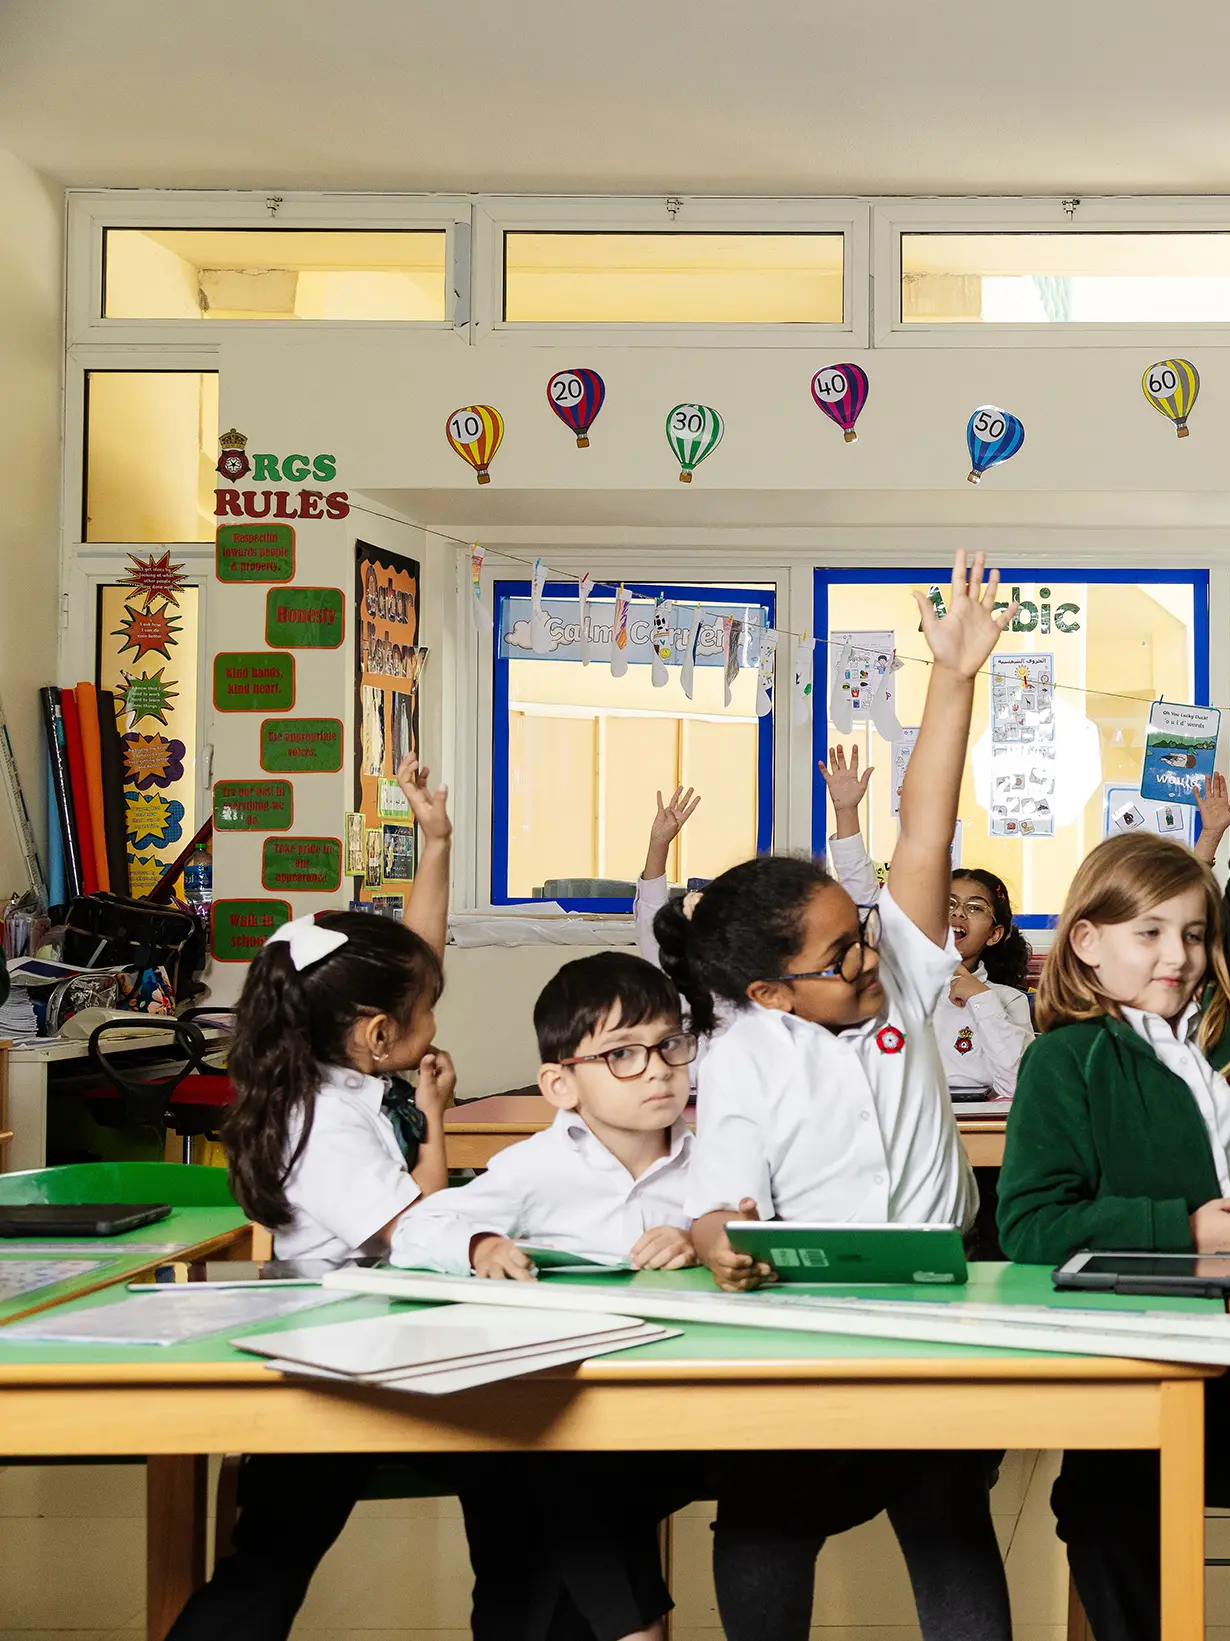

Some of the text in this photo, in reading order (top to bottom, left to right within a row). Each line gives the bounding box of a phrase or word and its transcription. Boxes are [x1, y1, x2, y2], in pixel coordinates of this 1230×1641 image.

[553, 378, 582, 401] 20
[816, 374, 846, 396] 40
[1148, 370, 1176, 393] 60
[451, 416, 480, 440] 10
[673, 411, 702, 434] 30
[974, 412, 1005, 438] 50
[252, 454, 336, 482] RGS
[214, 489, 350, 520] RULES
[233, 533, 278, 543] Respectful
[222, 547, 288, 558] towards people
[230, 562, 236, 570] &
[366, 565, 414, 625] Qatar
[276, 606, 336, 626] Honesty
[918, 586, 1080, 634] Abic
[630, 620, 724, 648] Crer
[226, 668, 248, 678] Kind
[228, 684, 250, 694] kind
[268, 732, 336, 742] Use appropriate
[288, 748, 317, 757] voices.
[238, 788, 253, 796] our
[256, 787, 274, 796] best
[276, 786, 284, 796] in
[272, 802, 284, 810] we
[274, 844, 332, 854] Take pride in
[294, 860, 310, 868] our
[230, 914, 274, 927] Walk in
